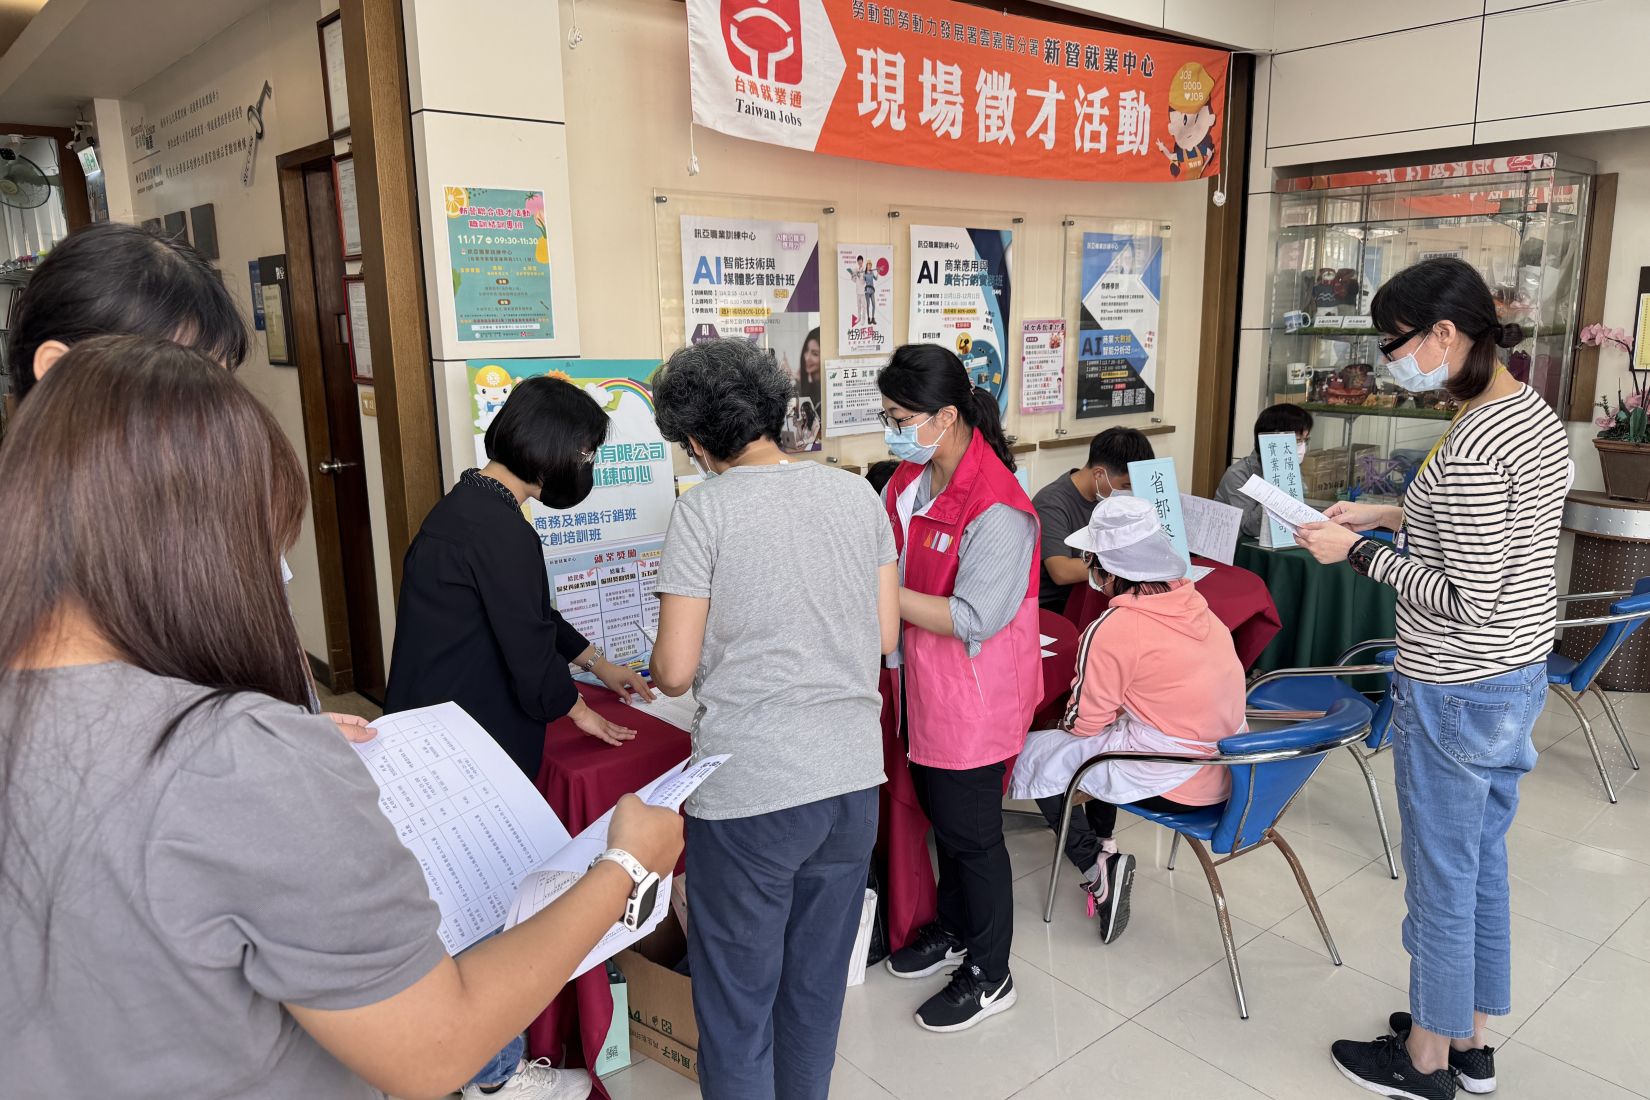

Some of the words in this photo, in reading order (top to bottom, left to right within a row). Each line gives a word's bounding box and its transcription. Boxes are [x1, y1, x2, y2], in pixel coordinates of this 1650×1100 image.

[852, 0, 1039, 56] 勞動部勞動力發展署雲嘉南分署
[1044, 38, 1155, 78] 新營就業中心
[1180, 71, 1192, 80] JOB
[734, 76, 802, 109] 台灣就業通
[1190, 92, 1204, 100] JOB
[857, 46, 1151, 156] 現場徵才活動
[736, 98, 777, 120] Taiwan
[779, 108, 802, 128] Jobs
[457, 234, 483, 244] 11/17
[694, 228, 756, 241] 訊亞職業訓練中心
[918, 240, 959, 250] 訊亞職業訓練中心
[724, 256, 775, 270] 智能技術與
[945, 259, 988, 272] 商業應用與
[693, 256, 722, 285] AI
[917, 260, 938, 284] AI
[724, 273, 795, 286] 媒體影音設計班
[702, 326, 709, 335] AI
[1082, 336, 1102, 356] AI
[843, 369, 858, 378] 五五
[595, 442, 665, 463] 有限公司
[535, 508, 637, 530] 商務及網路行銷班
[541, 528, 602, 547] 文創培訓班
[649, 559, 659, 568] 給民
